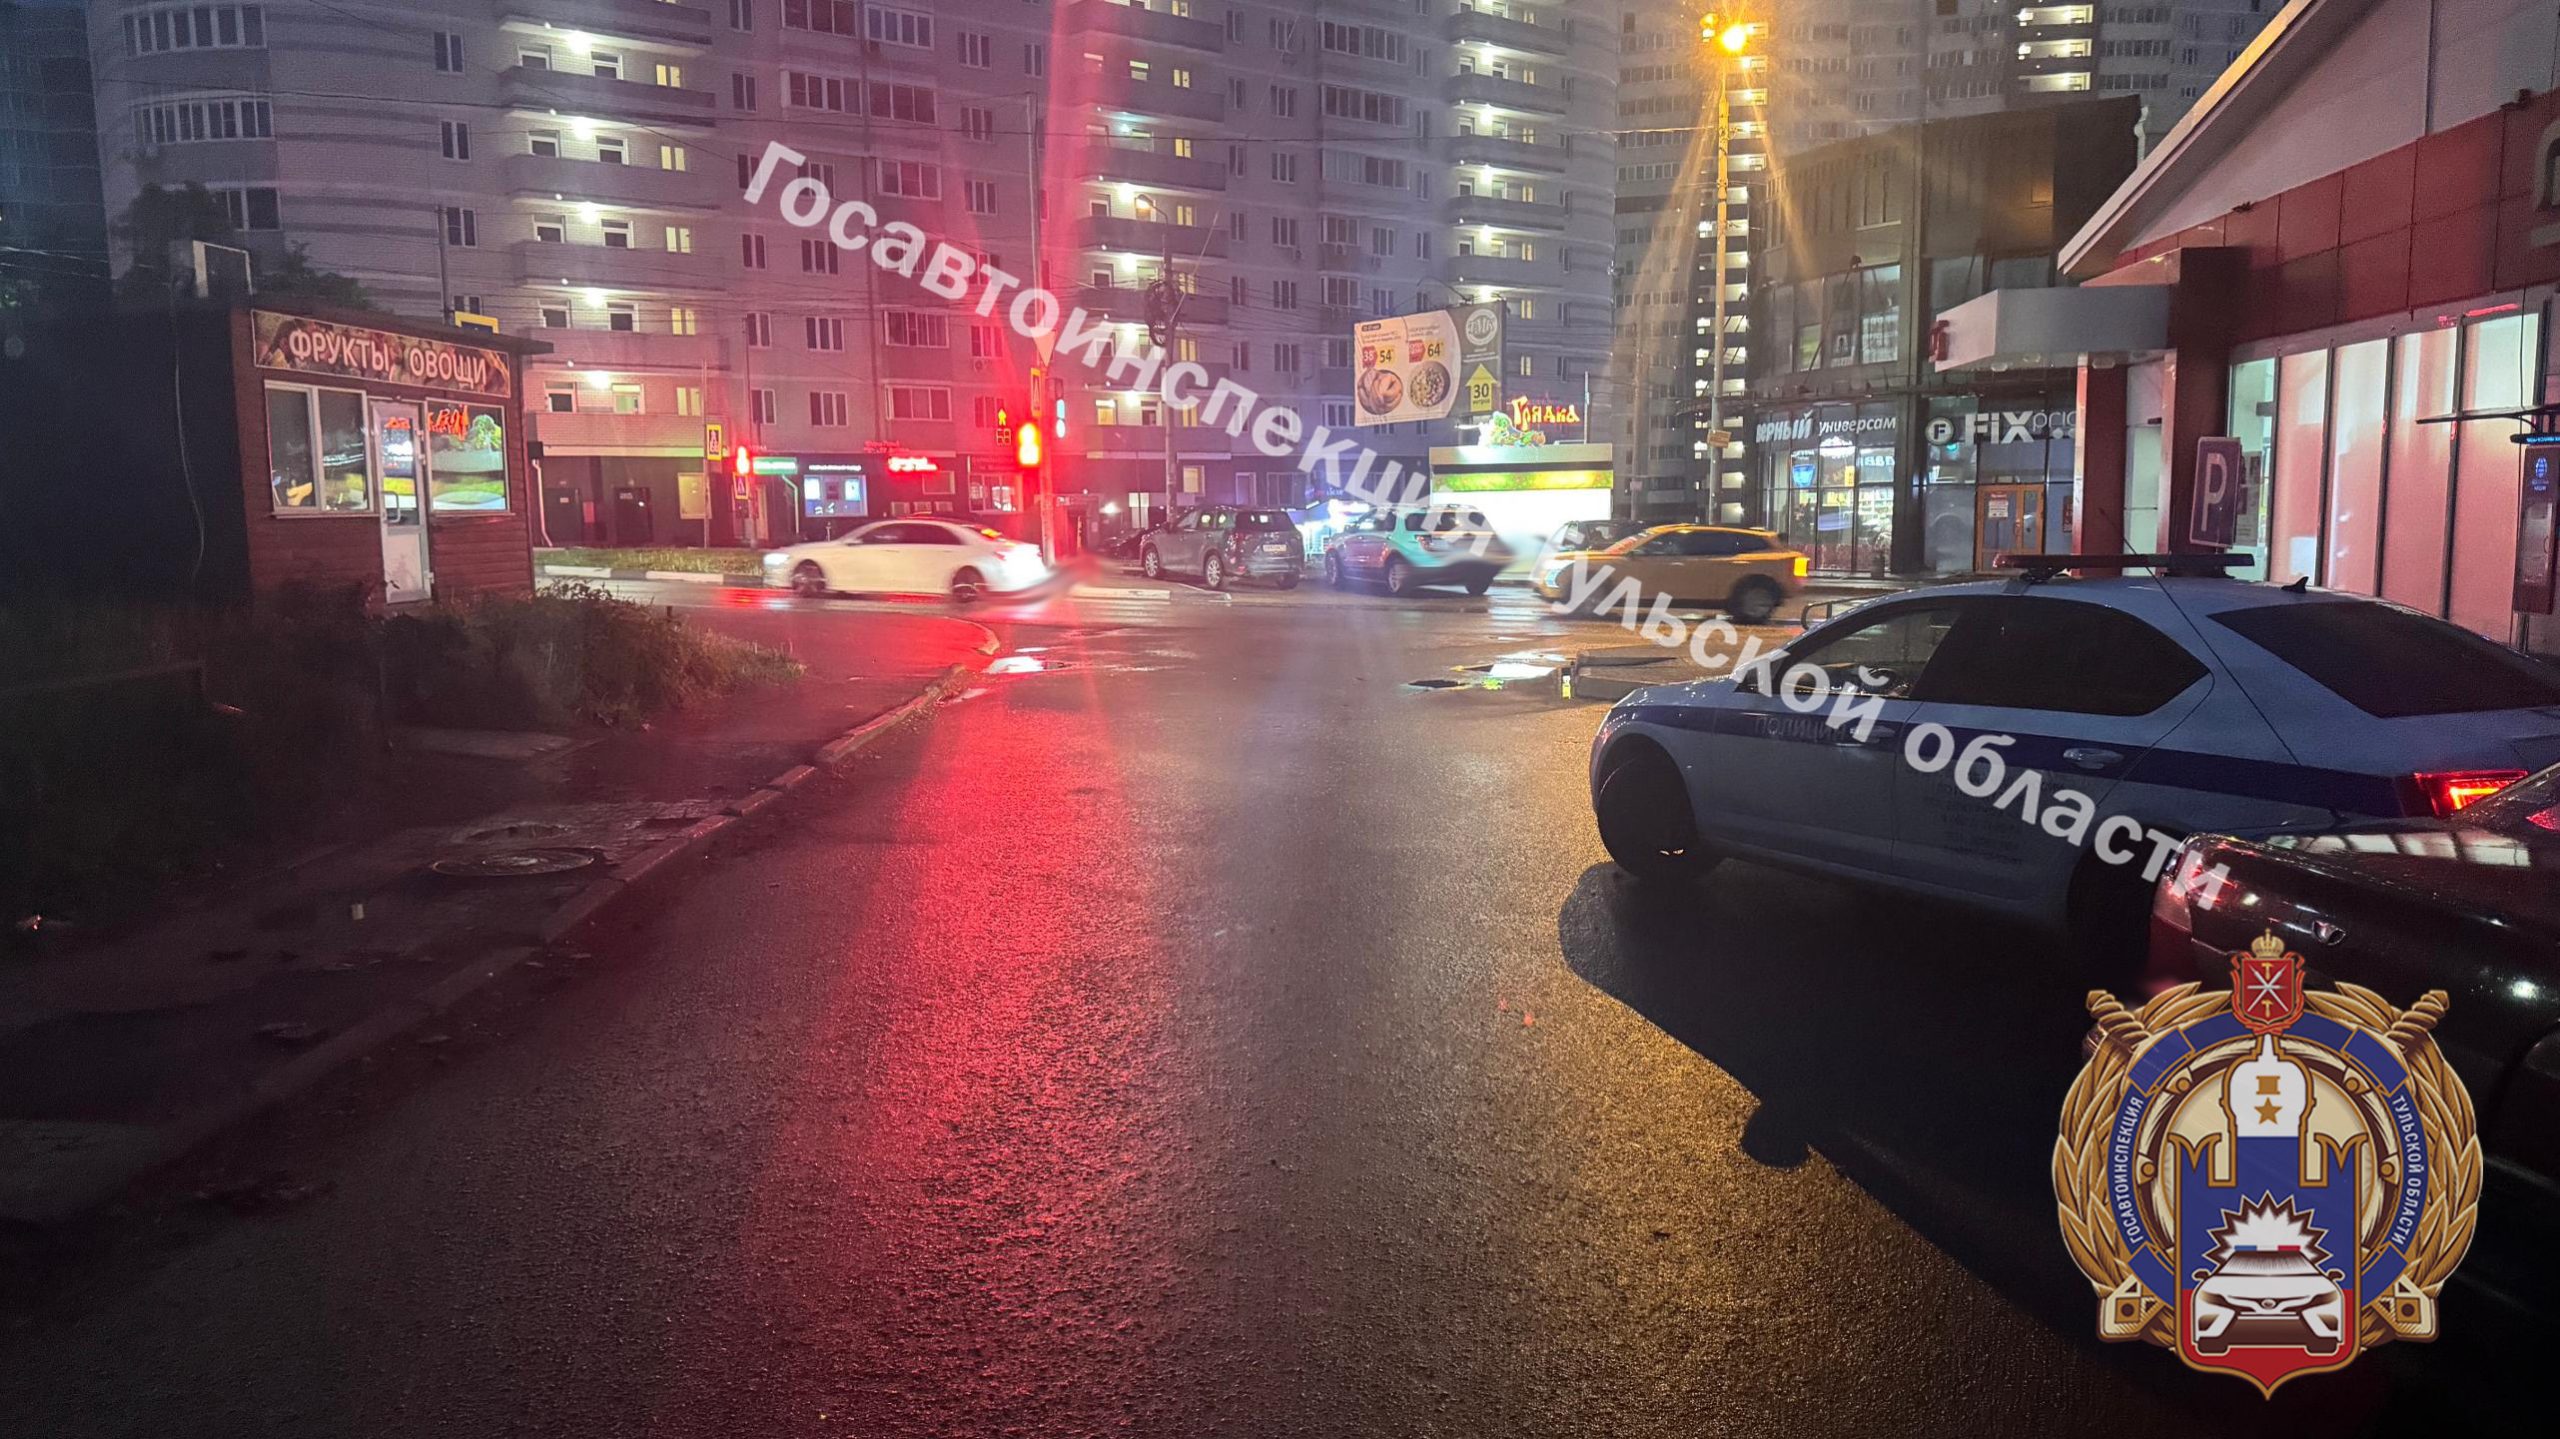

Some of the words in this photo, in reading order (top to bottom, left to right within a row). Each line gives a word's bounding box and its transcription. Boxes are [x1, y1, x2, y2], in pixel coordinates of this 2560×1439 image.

[289, 329, 394, 382] ФРУКТЫ,
[409, 347, 487, 388] ОВОЩИ
[1380, 349, 1392, 363] 54
[1427, 343, 1440, 357] 64
[1473, 383, 1490, 399] 30
[1818, 417, 1896, 436] универсам
[2033, 410, 2077, 432] pric
[2200, 452, 2227, 532] P
